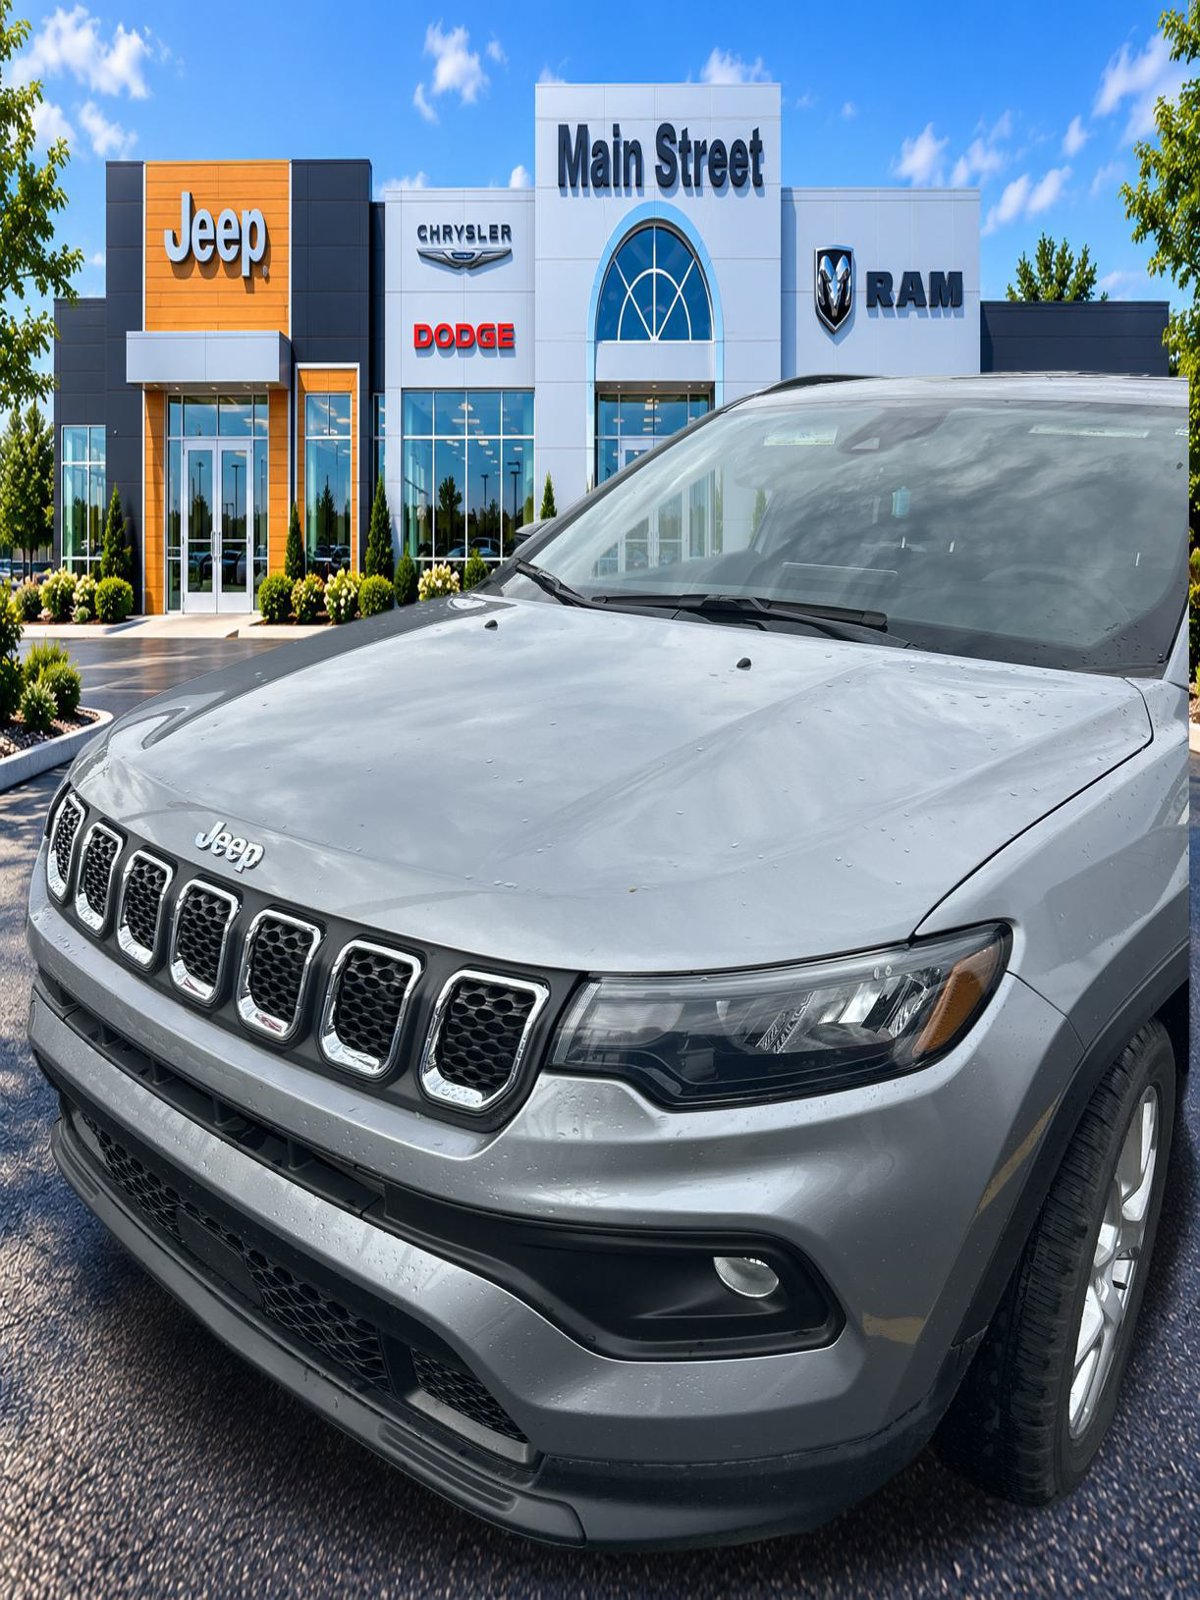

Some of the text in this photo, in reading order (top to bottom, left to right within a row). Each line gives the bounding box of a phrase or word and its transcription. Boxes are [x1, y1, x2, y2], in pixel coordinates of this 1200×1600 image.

[558, 122, 763, 188] Main Street
[164, 191, 267, 278] Jeep
[417, 224, 512, 242] CHRYSLER
[866, 271, 963, 307] RAM
[414, 322, 515, 349] DODGE
[195, 821, 265, 873] Jeep
